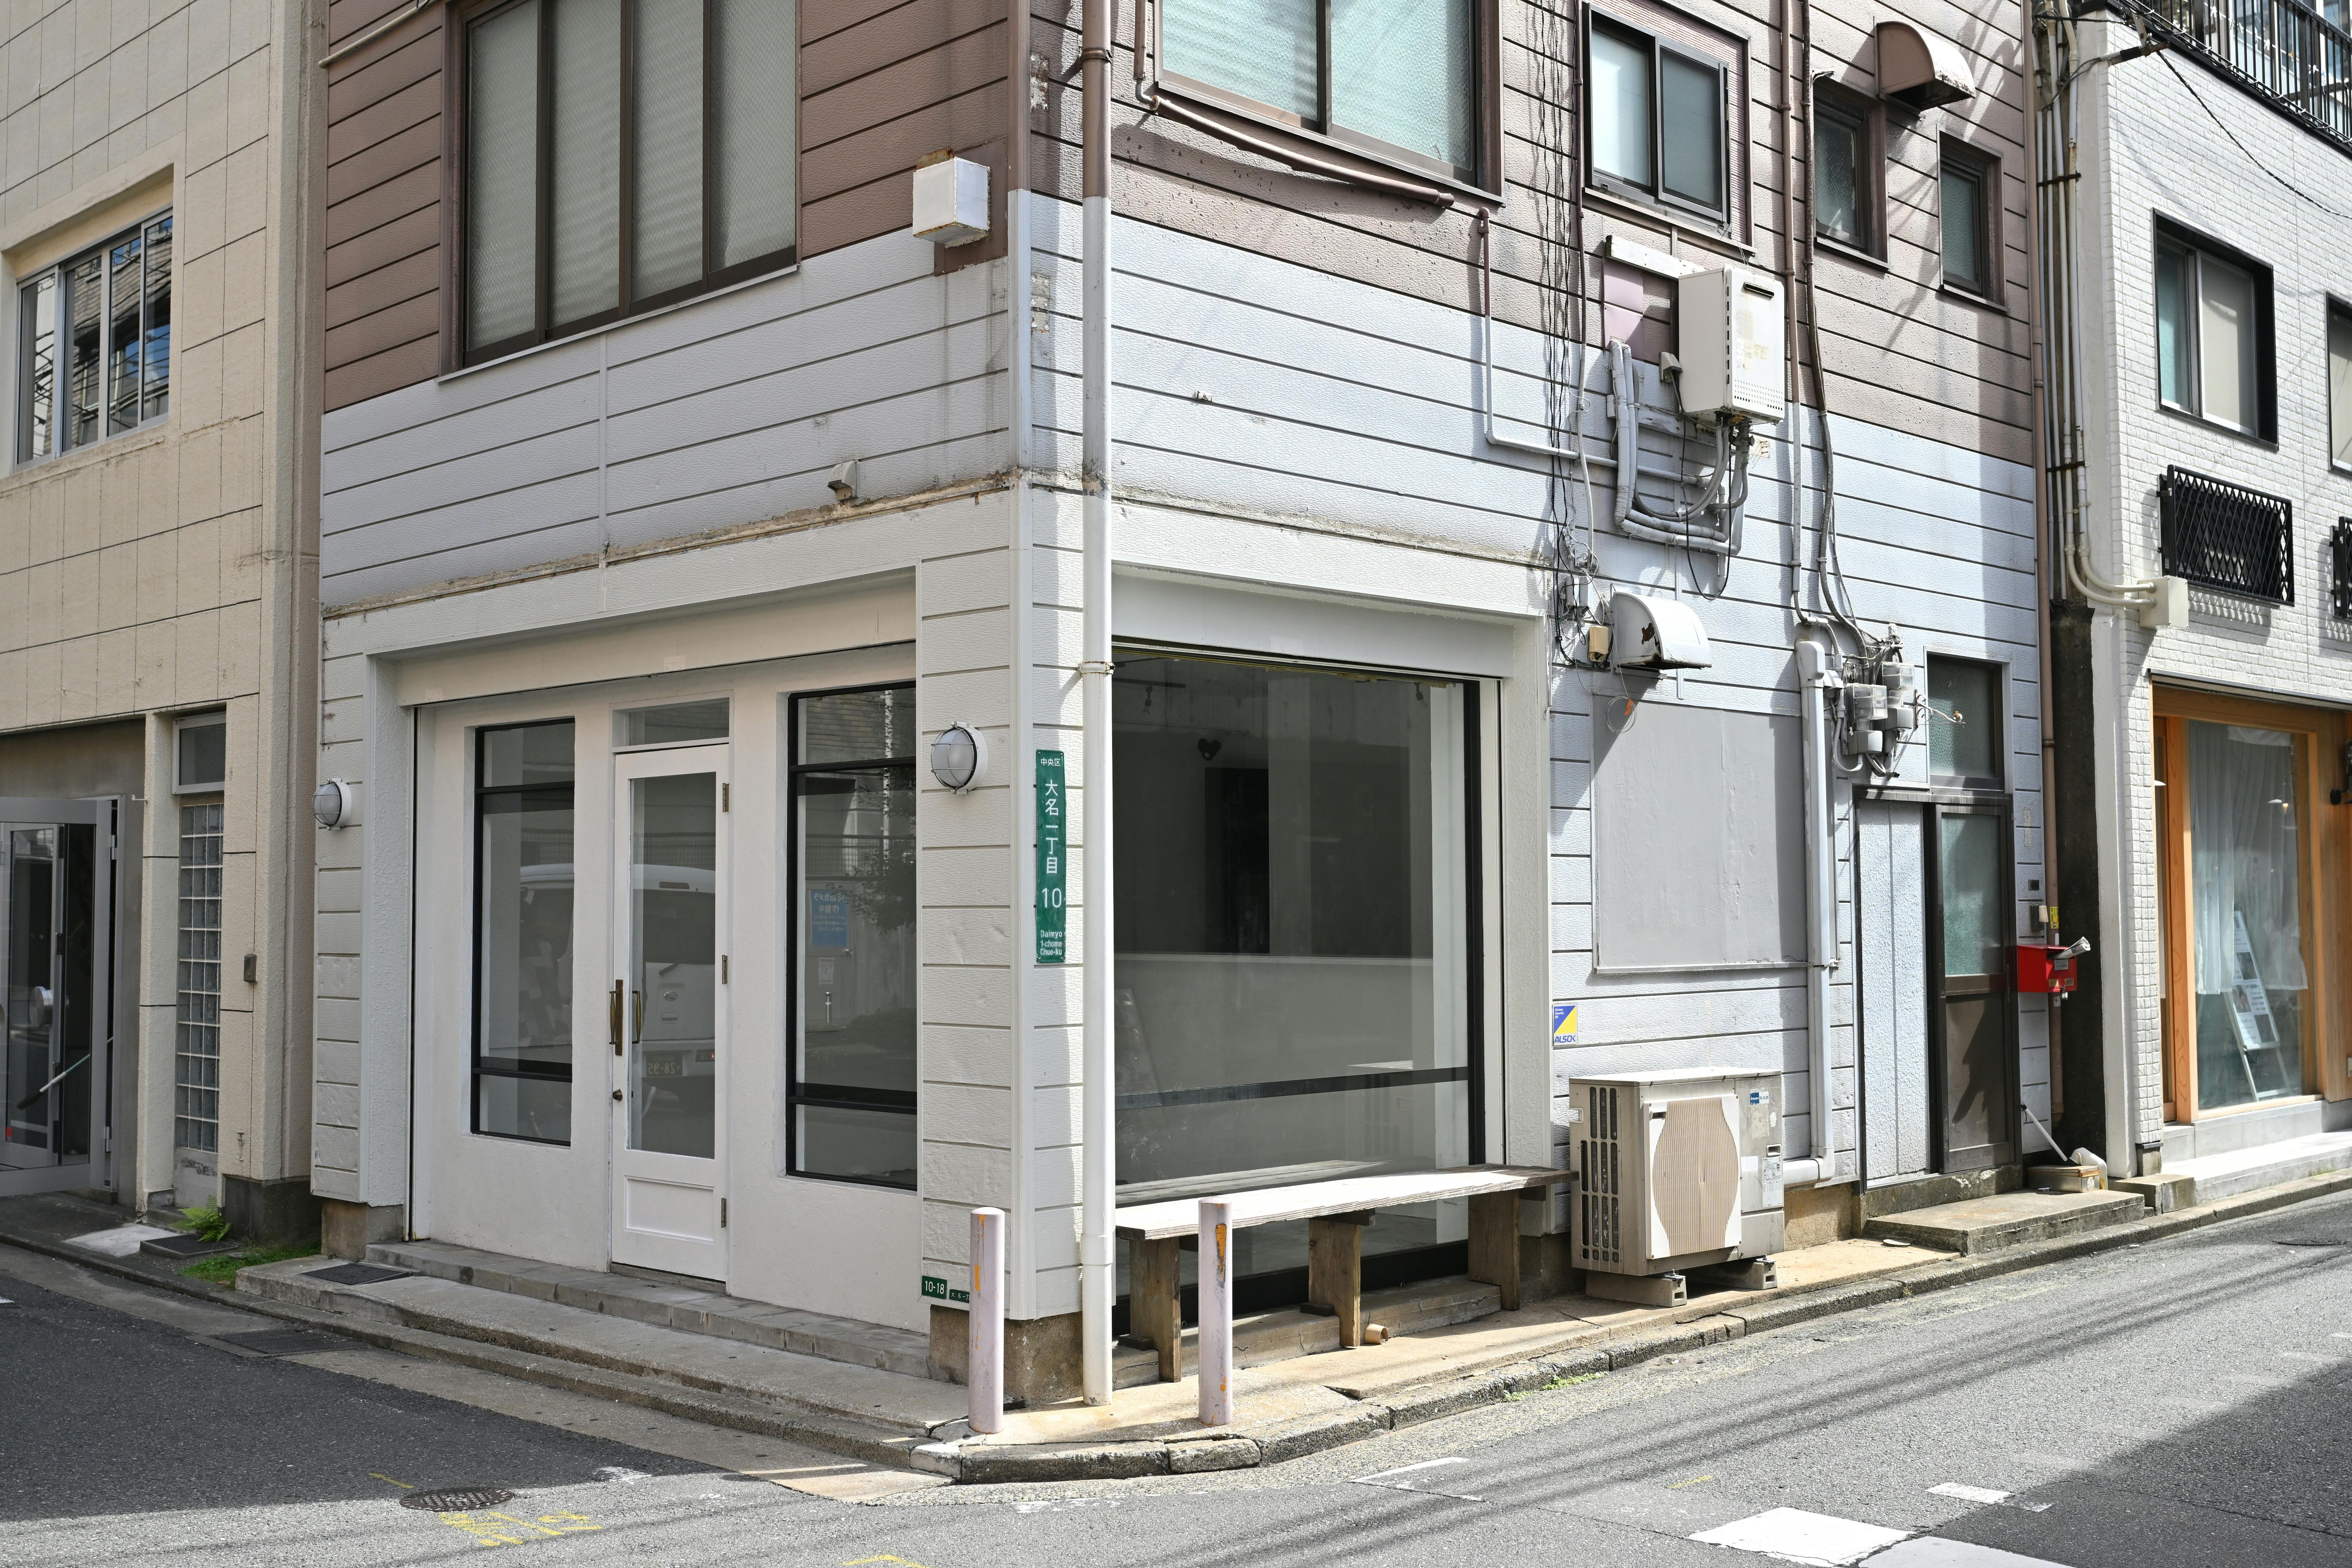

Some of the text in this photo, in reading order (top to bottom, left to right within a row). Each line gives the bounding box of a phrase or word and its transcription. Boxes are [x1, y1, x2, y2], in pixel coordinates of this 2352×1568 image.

[1041, 757, 1061, 766] 中央区
[1042, 779, 1062, 908] 大名一丁目 10
[1040, 930, 1062, 939] Daimyo
[925, 1280, 945, 1295] 10-18
[951, 1292, 969, 1301] 大名一丁
